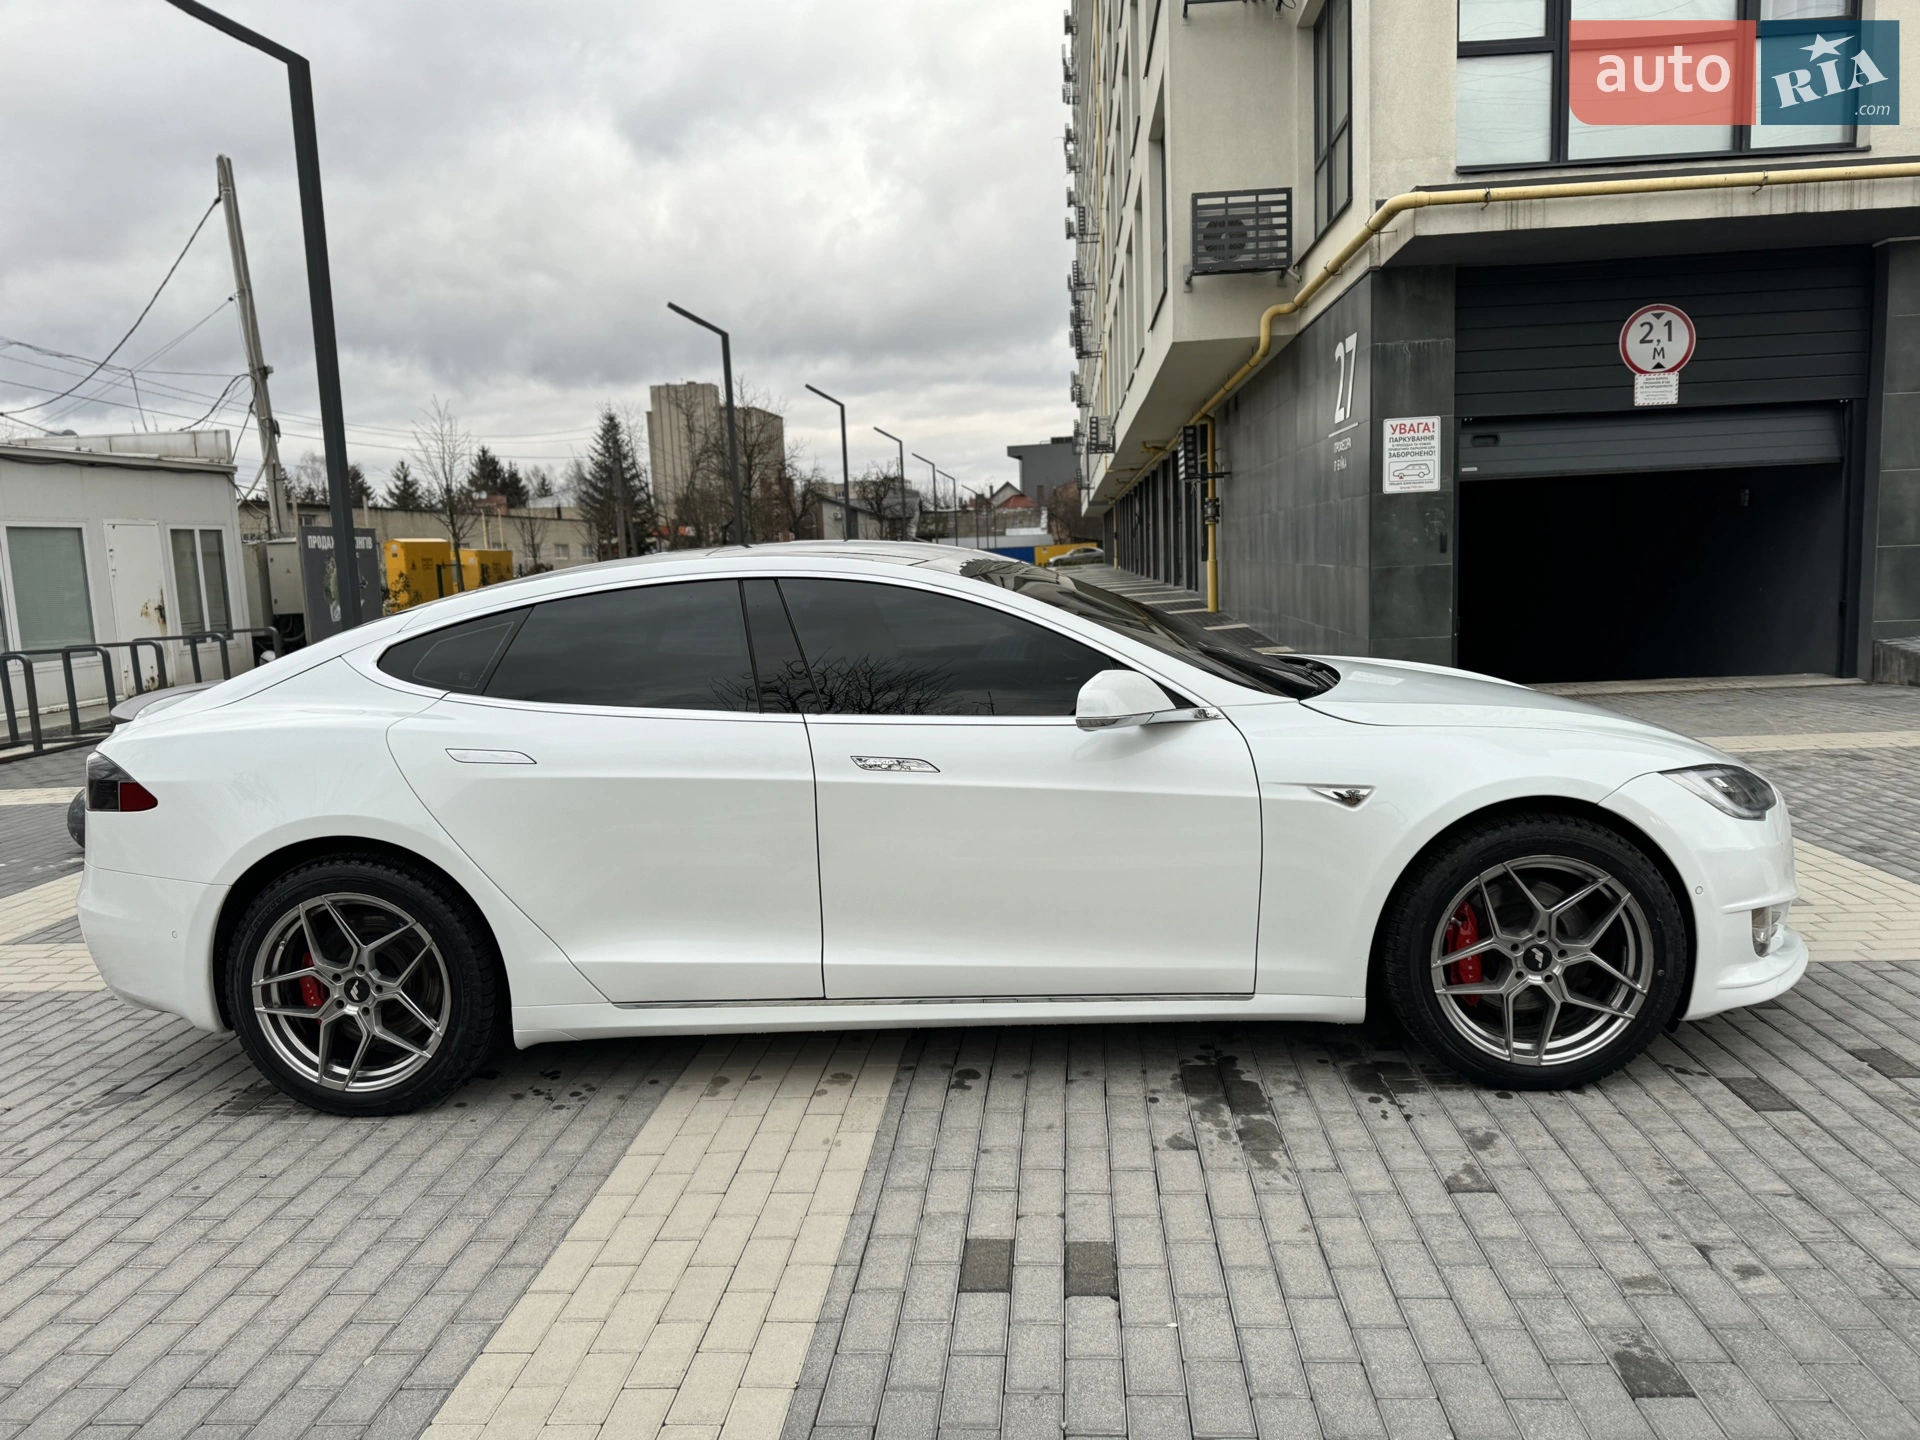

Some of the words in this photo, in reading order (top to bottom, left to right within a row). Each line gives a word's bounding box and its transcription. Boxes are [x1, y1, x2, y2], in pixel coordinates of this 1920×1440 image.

[1639, 319, 1673, 346] 2,1
[1334, 332, 1357, 424] 27
[1390, 421, 1436, 435] УВАГА!
[1388, 435, 1435, 443] ПАРКУВАННЯ
[1388, 450, 1436, 458] ЗАБОРОНЕНО!
